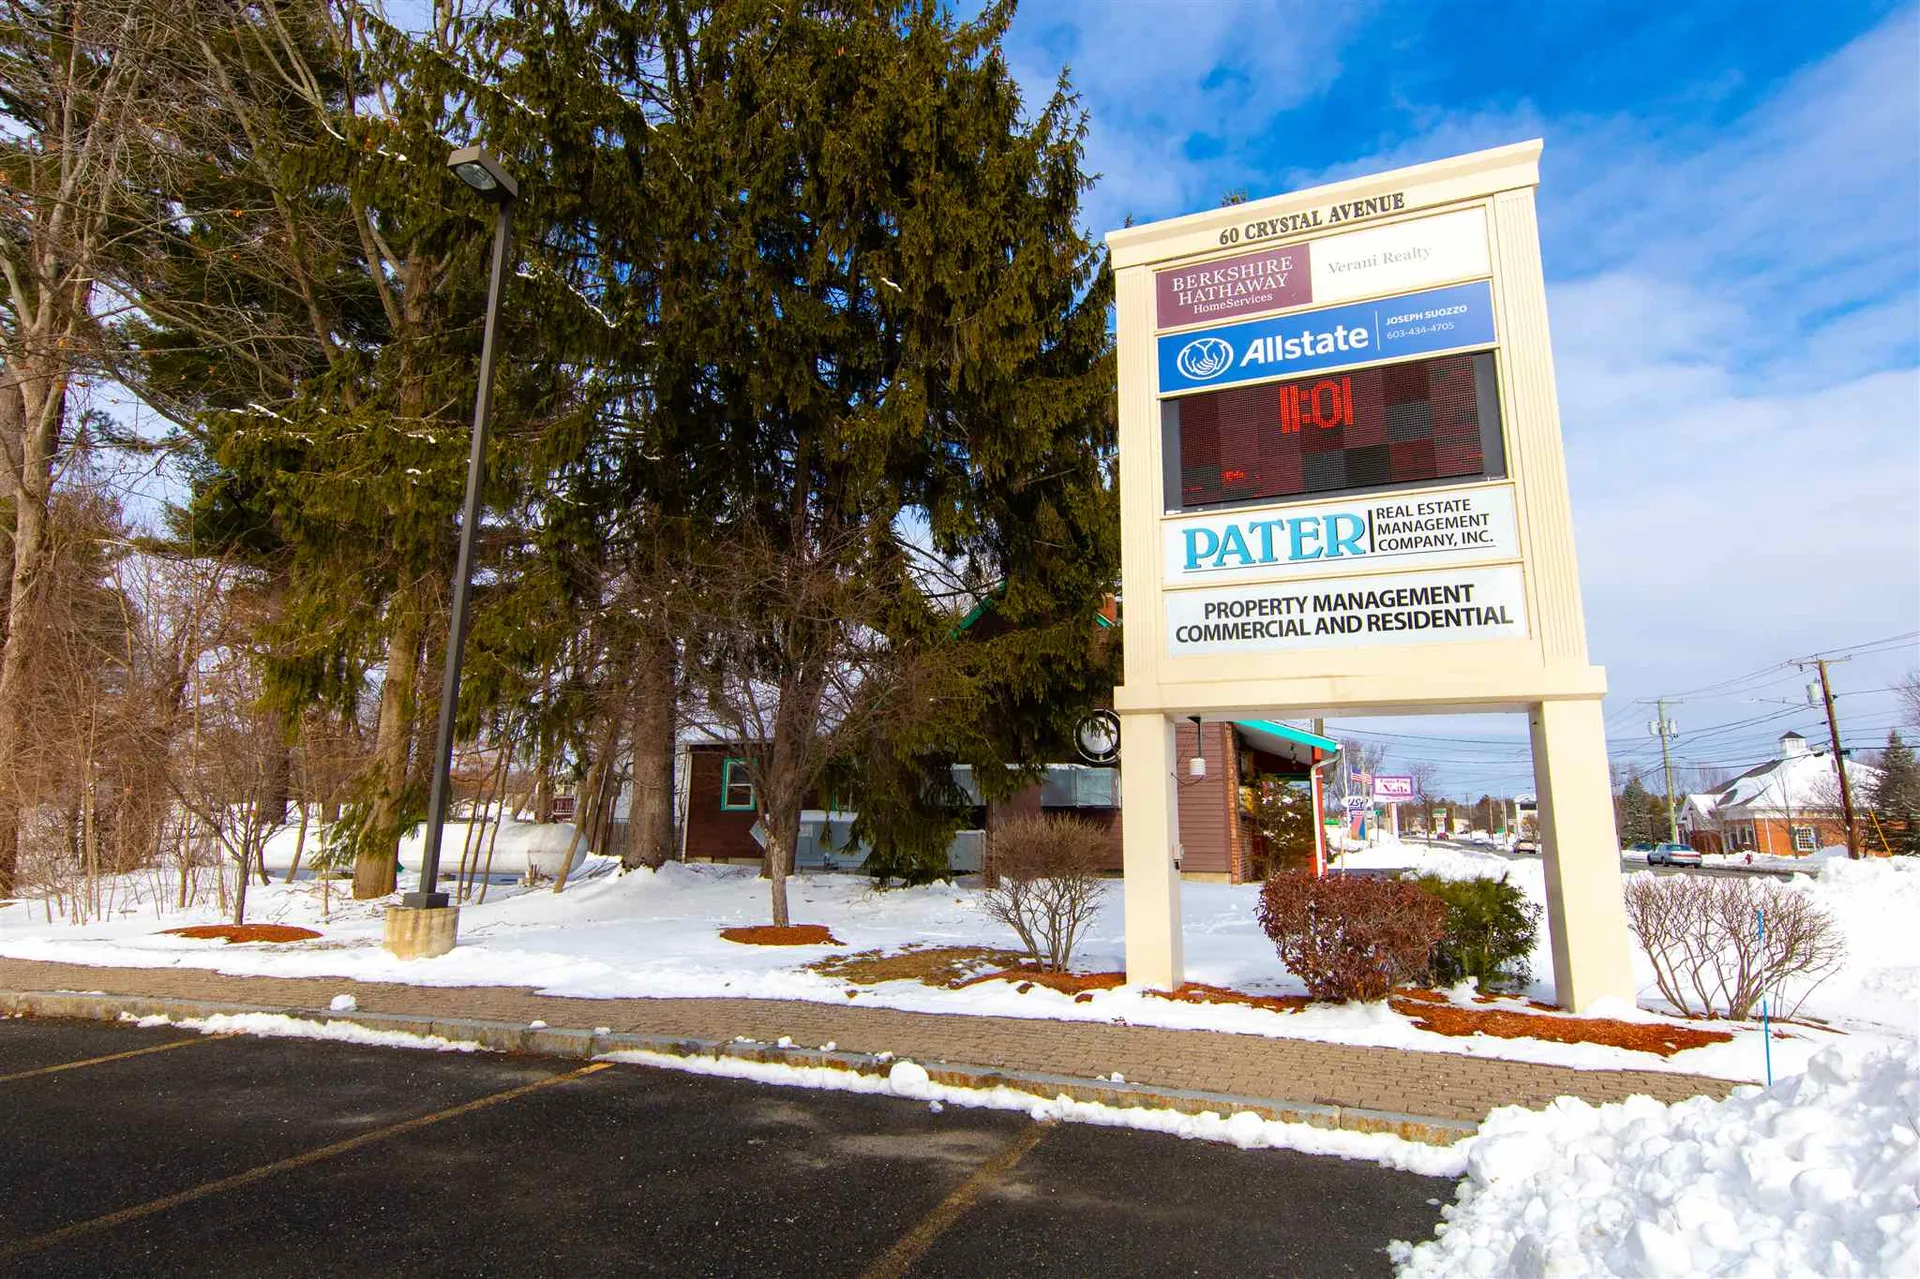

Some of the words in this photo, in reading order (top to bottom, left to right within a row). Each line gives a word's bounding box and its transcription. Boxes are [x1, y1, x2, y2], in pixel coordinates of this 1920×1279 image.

[1219, 224, 1239, 246] 60
[1244, 210, 1323, 241] CRYSTAL
[1328, 192, 1406, 224] AVENUE
[1172, 255, 1294, 292] BERKSHIRE
[1327, 256, 1378, 275] Verani
[1382, 246, 1433, 266] Realty
[1178, 273, 1289, 306] HATHAWAY
[1192, 292, 1273, 315] HomeServices
[1385, 313, 1423, 326] JOSEPH
[1424, 304, 1468, 319] SUOZZO
[1386, 321, 1456, 340] 603-434-4705
[1240, 324, 1369, 367] Allstate
[1376, 505, 1414, 520] REAL
[1417, 498, 1472, 515] ESTATE
[1377, 513, 1490, 535] MANAGEMENT
[1182, 513, 1368, 570] PATER
[1378, 534, 1458, 552] COMPANY,
[1461, 529, 1494, 546] INC.
[1204, 596, 1309, 620] PROPERTY
[1313, 584, 1474, 613] MANAGEMENT
[1175, 617, 1311, 643] COMMERCIAL
[1314, 613, 1363, 636] AND
[1367, 605, 1514, 632] RESIDENTIAL
